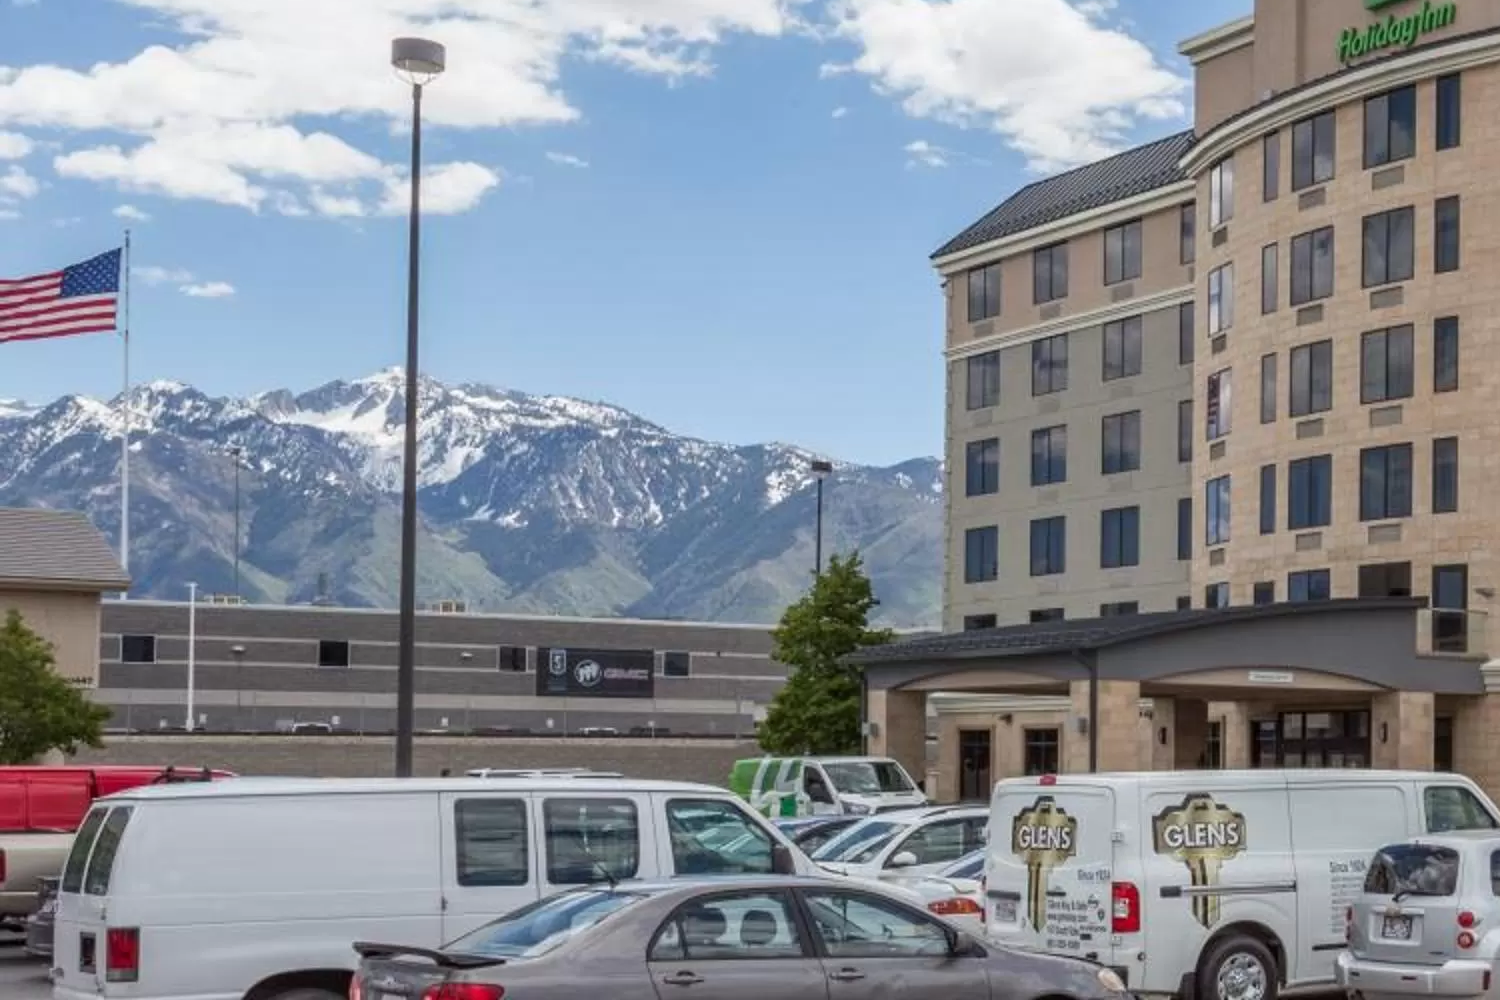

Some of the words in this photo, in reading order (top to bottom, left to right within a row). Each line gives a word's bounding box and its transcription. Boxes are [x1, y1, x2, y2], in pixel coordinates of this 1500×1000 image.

[1336, 14, 1419, 63] Holiday
[1420, 0, 1457, 34] Inn
[1019, 825, 1071, 849] GLENS
[1163, 822, 1239, 848] GLENS
